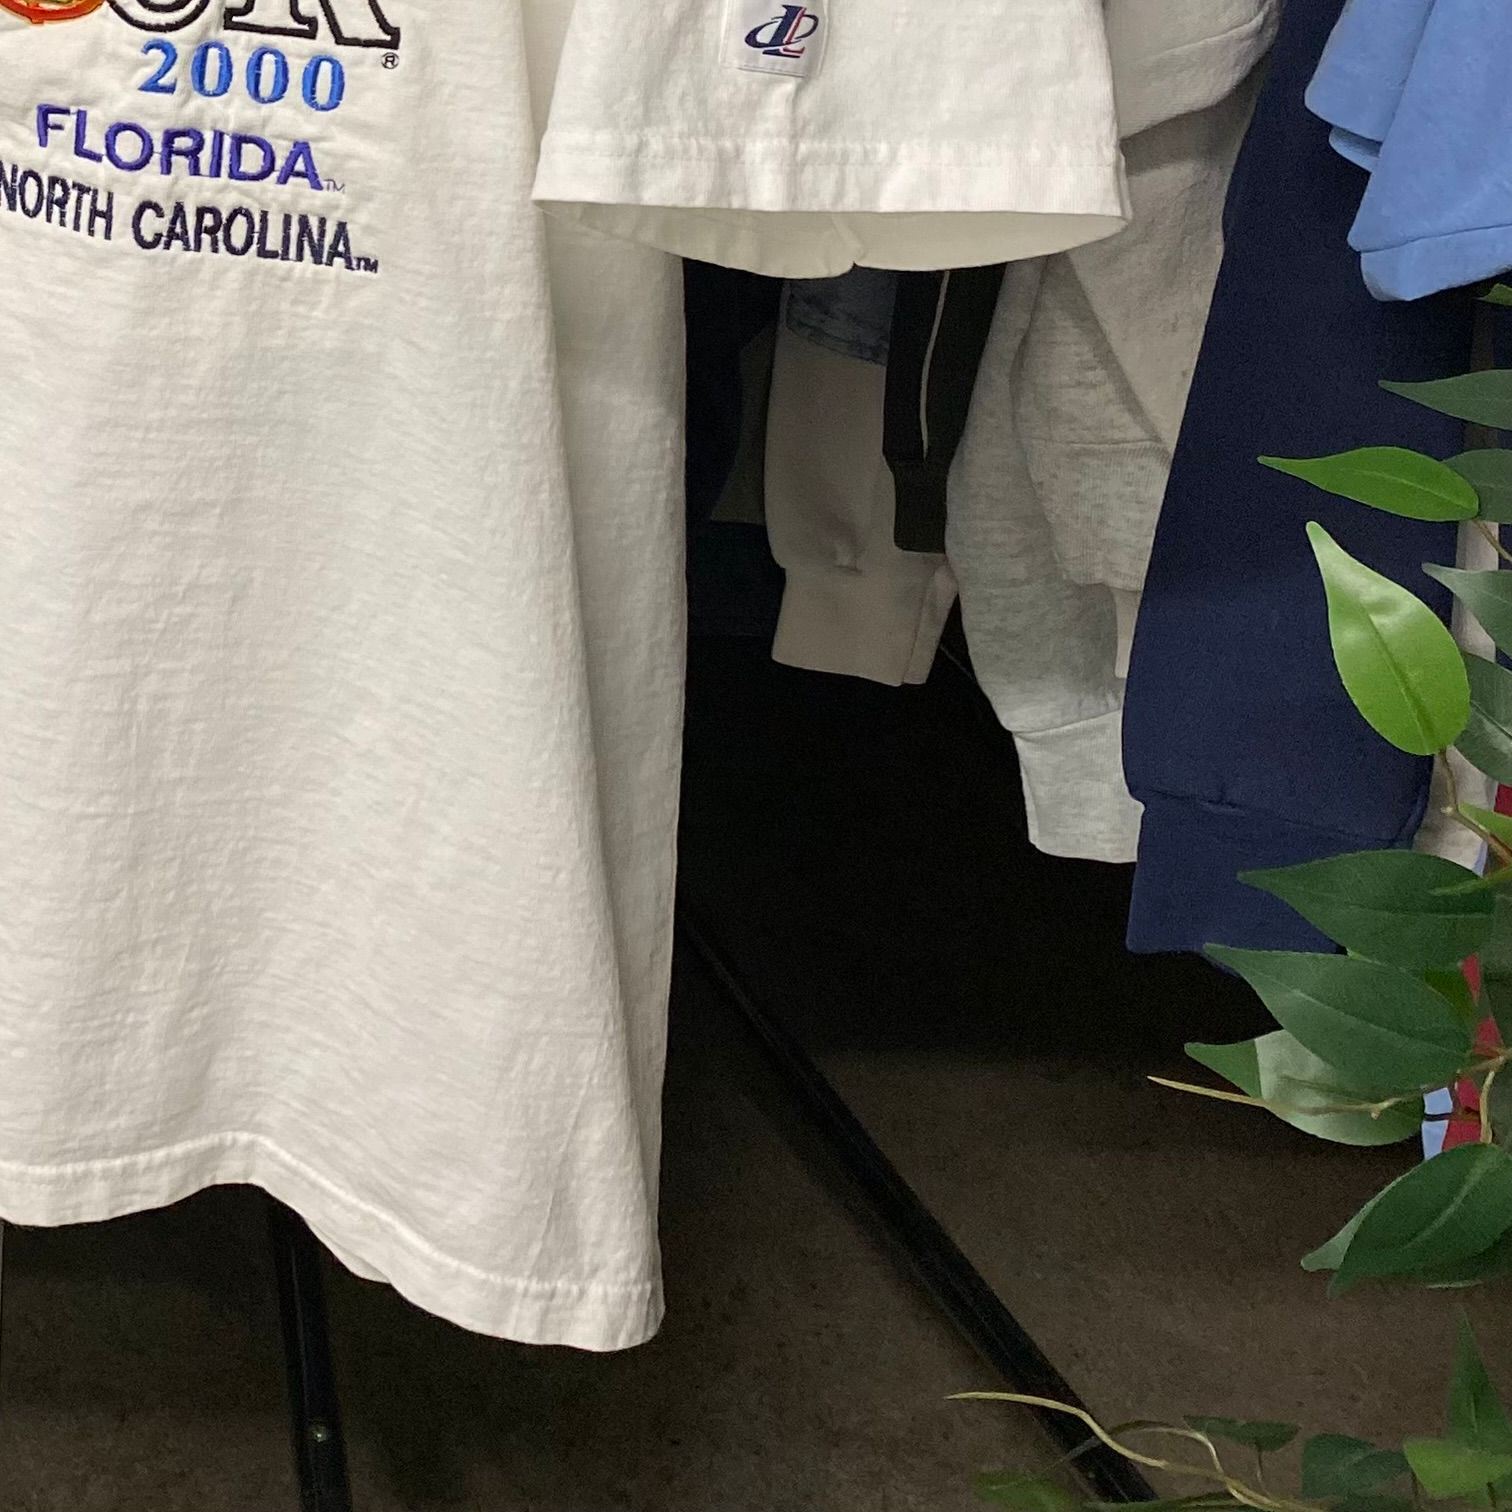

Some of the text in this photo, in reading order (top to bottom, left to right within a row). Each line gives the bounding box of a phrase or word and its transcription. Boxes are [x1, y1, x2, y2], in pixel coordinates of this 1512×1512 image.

[140, 38, 346, 112] 2000
[36, 103, 324, 191] FLORIDA
[131, 200, 356, 272] CAROLINA
